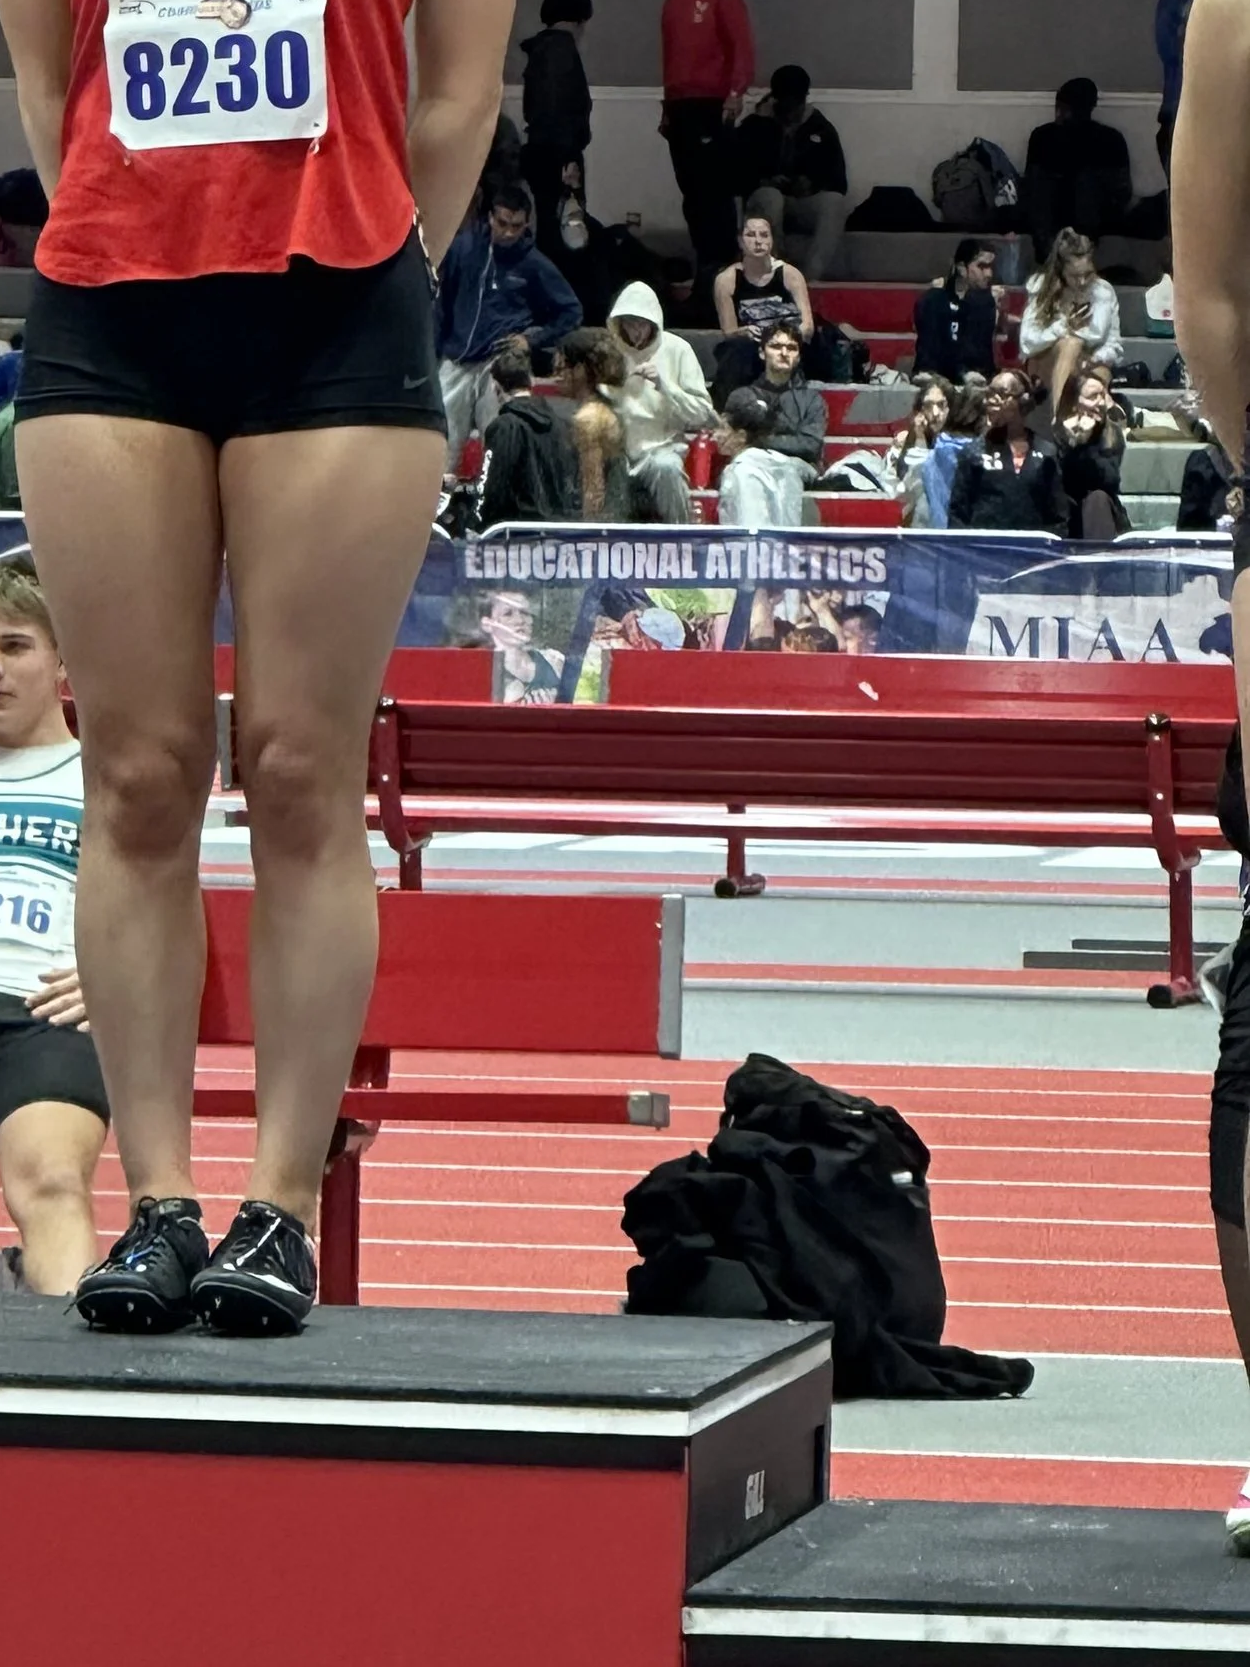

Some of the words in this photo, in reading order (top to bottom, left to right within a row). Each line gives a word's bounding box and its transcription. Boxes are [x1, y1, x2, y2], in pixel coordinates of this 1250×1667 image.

[123, 30, 311, 121] 8230
[465, 541, 698, 581] EDUCATIONAL
[704, 541, 887, 584] ATHLETICS
[985, 614, 1182, 663] MIAA
